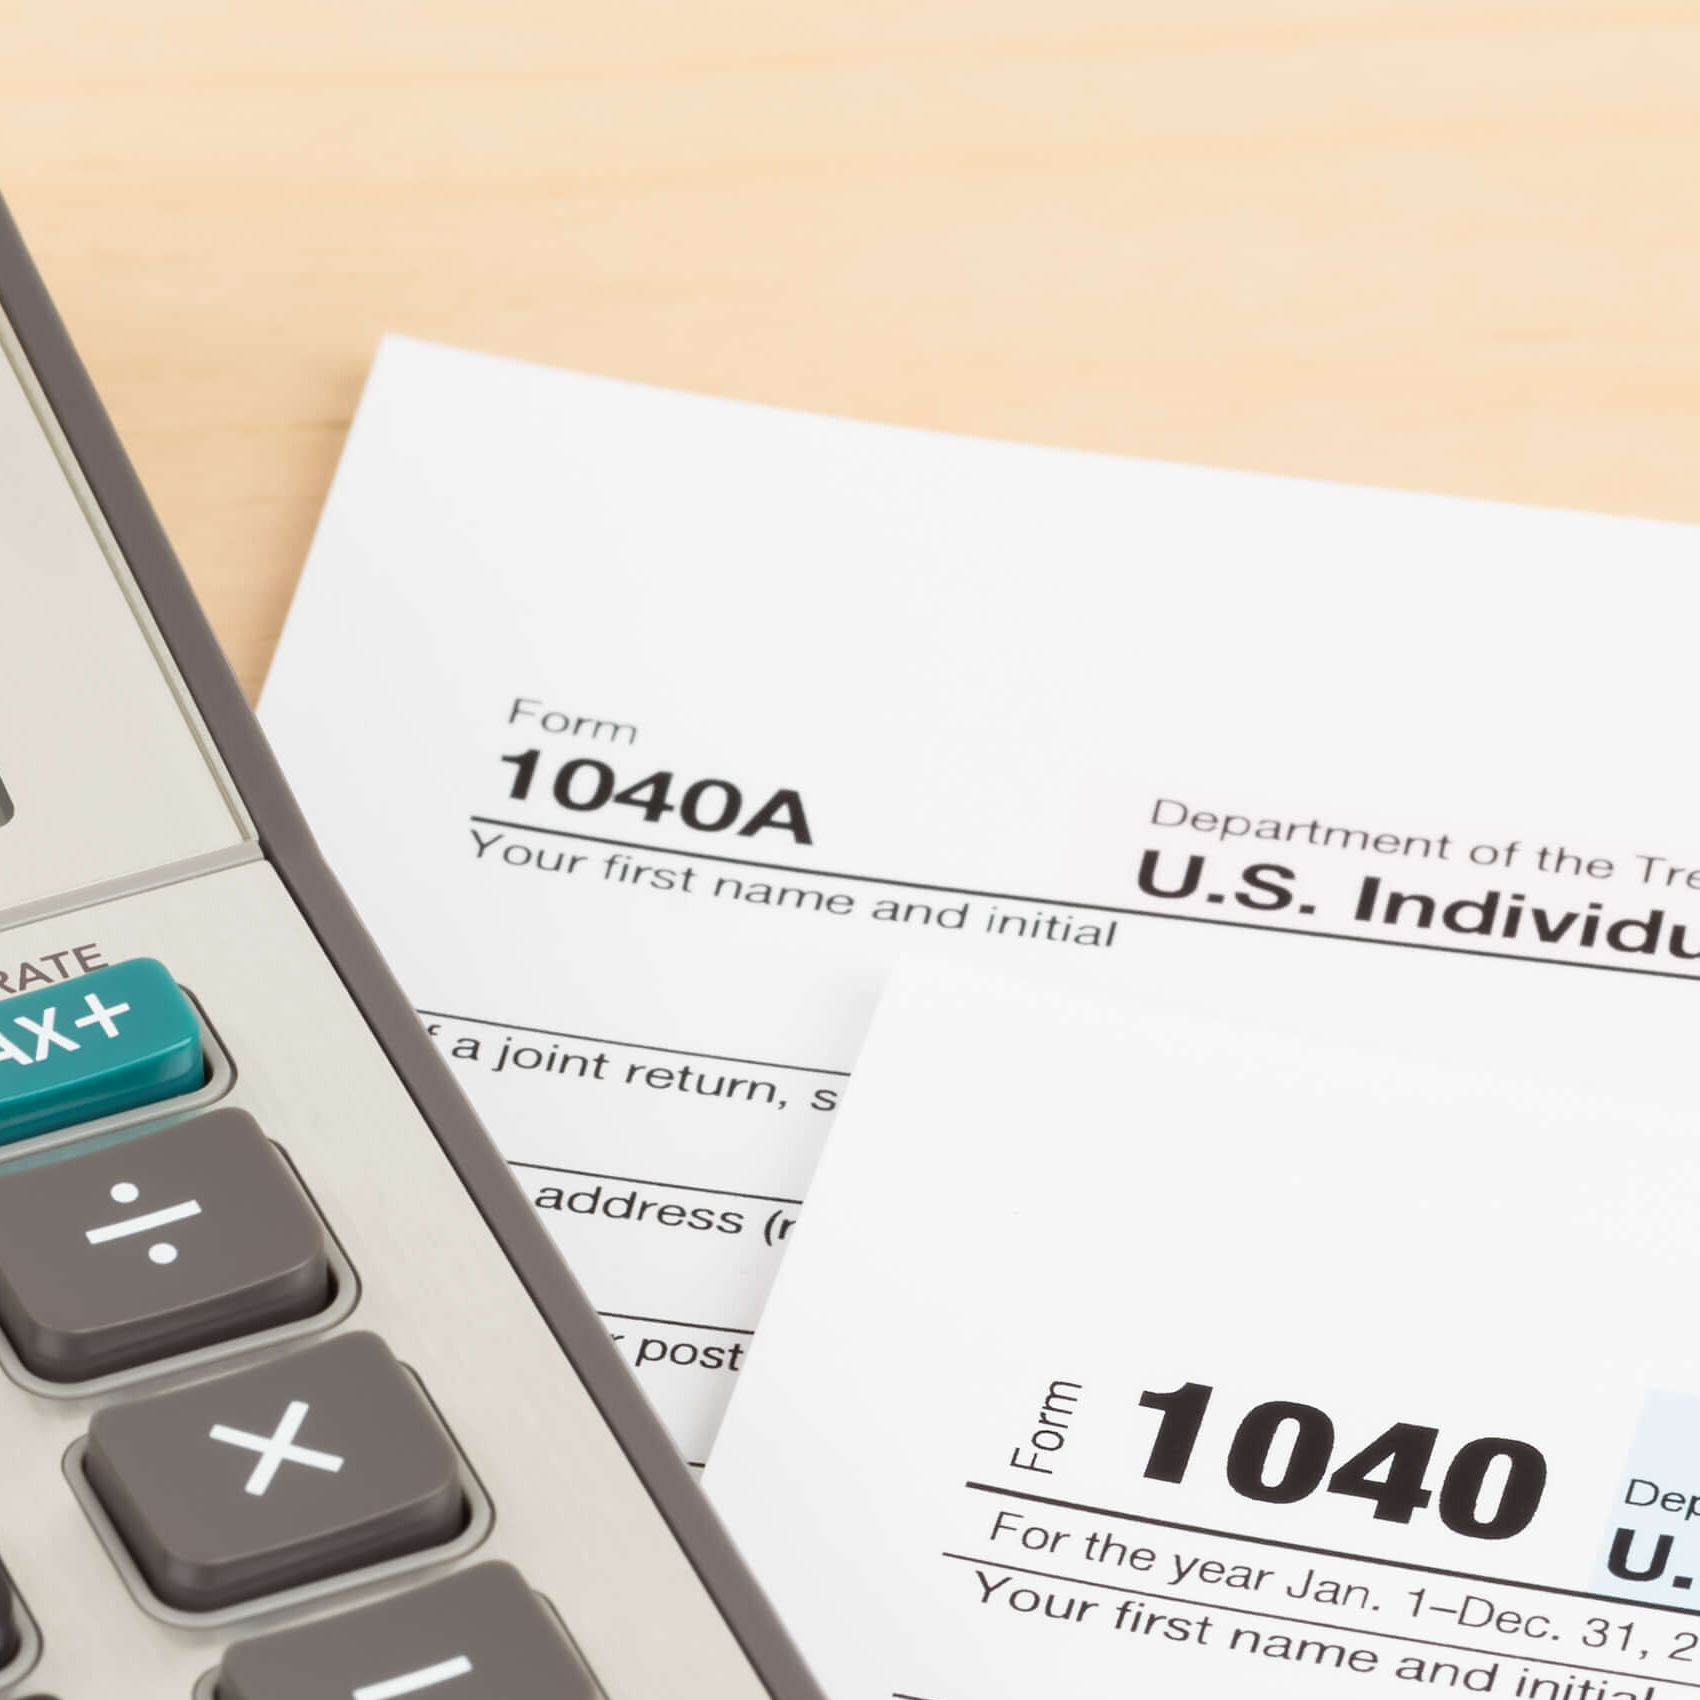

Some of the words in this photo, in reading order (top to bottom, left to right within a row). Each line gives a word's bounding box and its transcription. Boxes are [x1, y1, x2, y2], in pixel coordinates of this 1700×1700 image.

[508, 697, 637, 745] Form
[500, 747, 814, 847] 1040A
[1150, 798, 1451, 860] Department
[1469, 841, 1520, 868] of
[1537, 846, 1615, 879] the
[470, 828, 589, 874] Your
[604, 853, 696, 893] first
[713, 877, 855, 916] name
[871, 900, 970, 930] and
[986, 913, 1118, 948] initial
[1137, 848, 1317, 916] U.S.
[452, 1038, 480, 1061] a
[492, 1037, 609, 1080] joint
[625, 1064, 788, 1116] return,
[533, 1185, 745, 1235] address
[634, 1337, 746, 1373] post
[1011, 1378, 1082, 1475] Form
[1137, 1381, 1548, 1541] 1040
[989, 1510, 1072, 1553] For
[1084, 1531, 1157, 1572] the
[1166, 1553, 1276, 1591] year
[1285, 1568, 1381, 1612] Jan.
[1581, 1617, 1649, 1661] 31,
[974, 1569, 1100, 1623] Your
[1114, 1600, 1214, 1646] first
[1229, 1627, 1379, 1673] name
[1394, 1657, 1500, 1693] and
